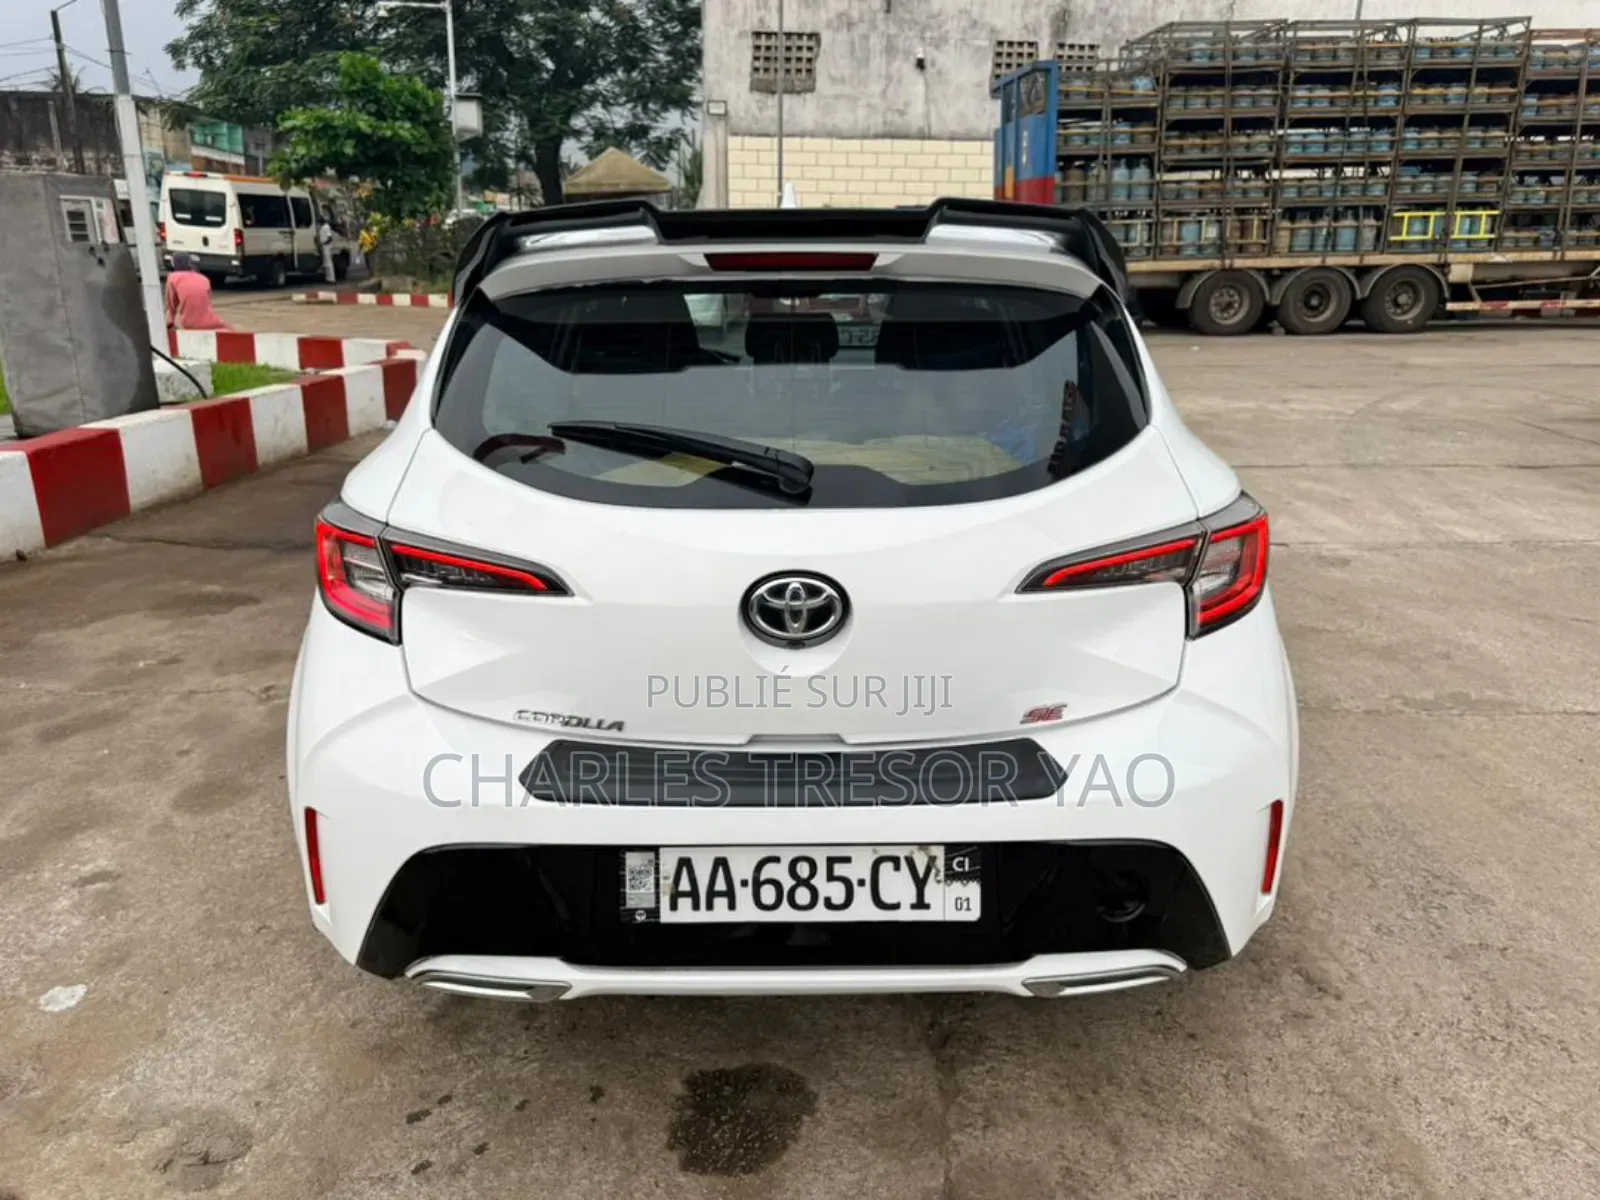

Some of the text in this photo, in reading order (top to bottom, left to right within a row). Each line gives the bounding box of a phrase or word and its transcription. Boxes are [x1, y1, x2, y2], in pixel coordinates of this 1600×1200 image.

[513, 709, 625, 732] COROLLA
[1019, 703, 1068, 725] SE
[952, 856, 970, 873] CI
[954, 896, 973, 913] 01
